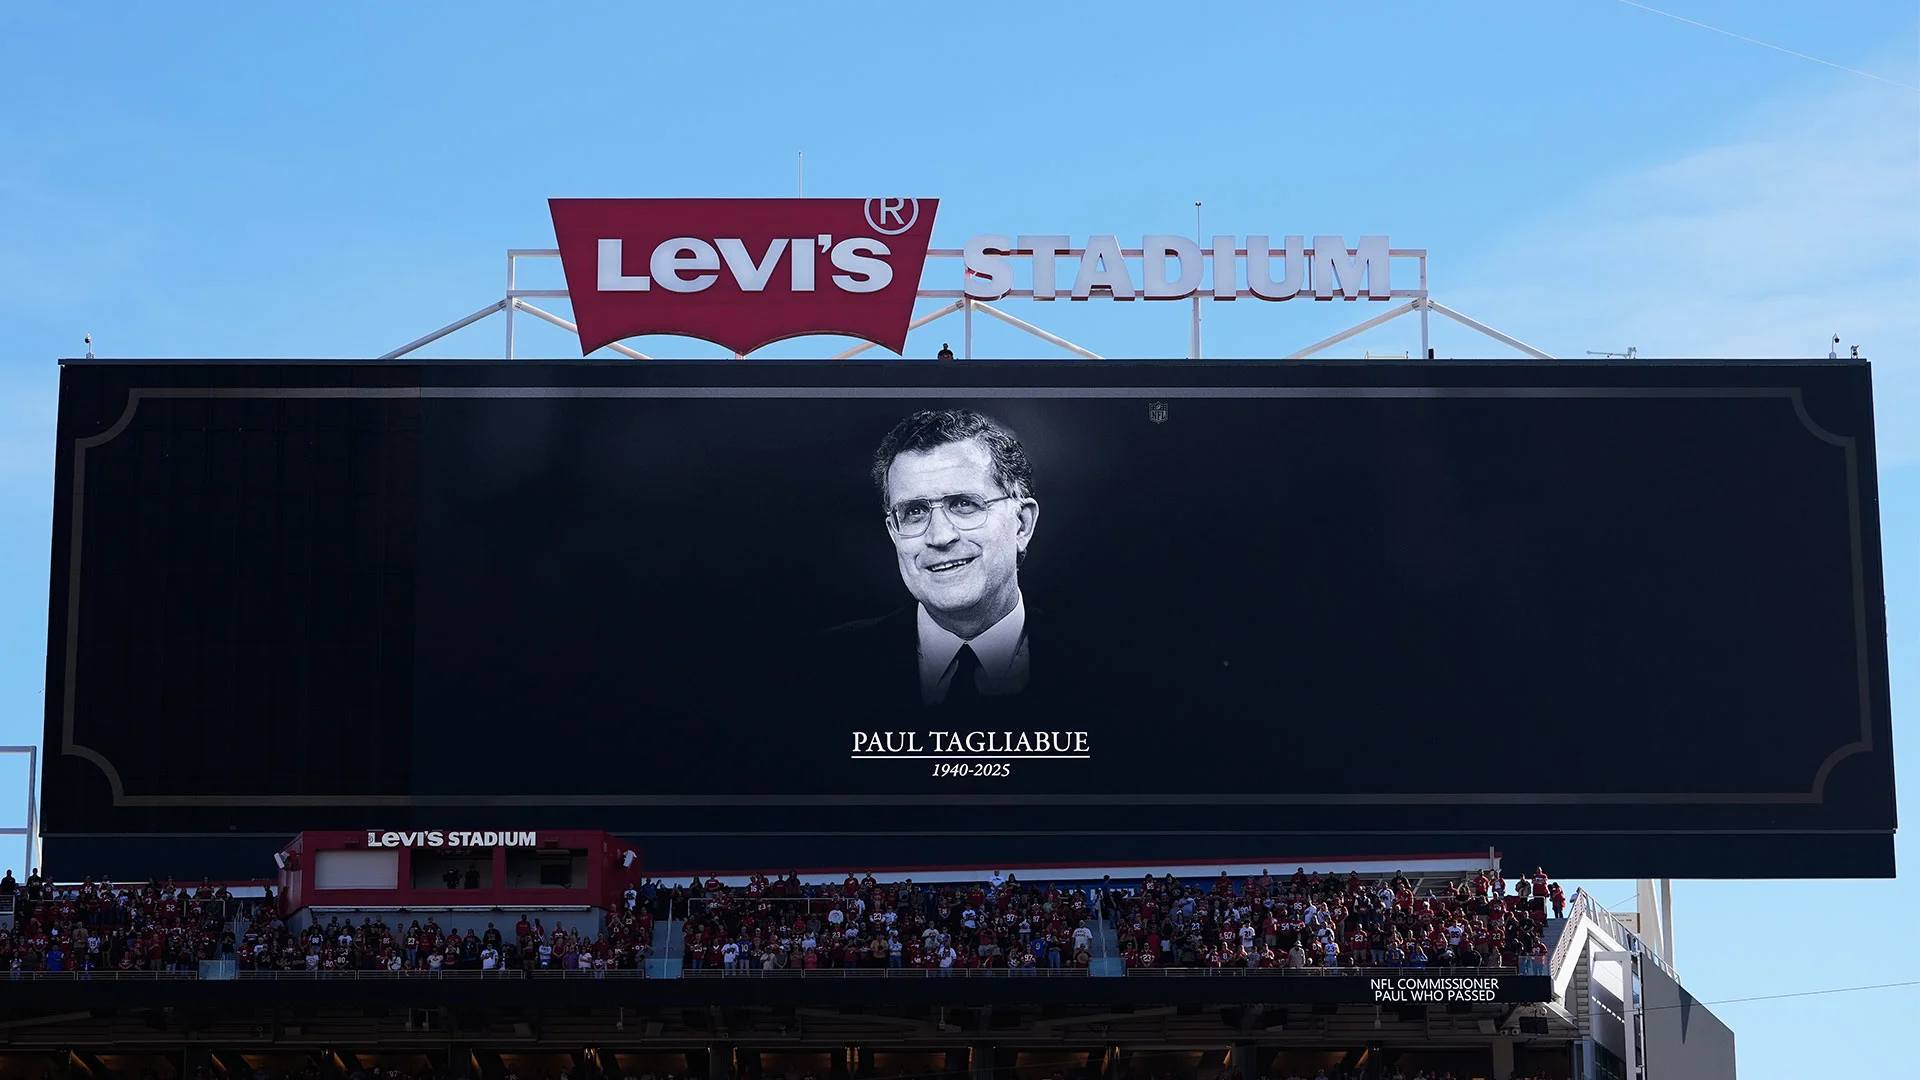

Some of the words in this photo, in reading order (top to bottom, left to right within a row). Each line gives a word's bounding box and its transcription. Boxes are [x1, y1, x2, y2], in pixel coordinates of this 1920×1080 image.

[964, 235, 1392, 301] STADIUM
[852, 731, 923, 753] PAUL
[928, 731, 1090, 753] TAGLIABUE
[932, 763, 1010, 778] 1940-2025
[448, 831, 537, 847] STADIUM
[1191, 923, 1200, 931] 23
[1493, 932, 1500, 940] 23
[741, 944, 748, 952] 10
[1142, 954, 1151, 962] 23
[1370, 978, 1395, 990] NFL
[1397, 978, 1500, 990] COMMISSIONER
[1374, 990, 1408, 1002] PAUL
[1410, 990, 1444, 1002] WHO
[1447, 990, 1496, 1002] PASSED
